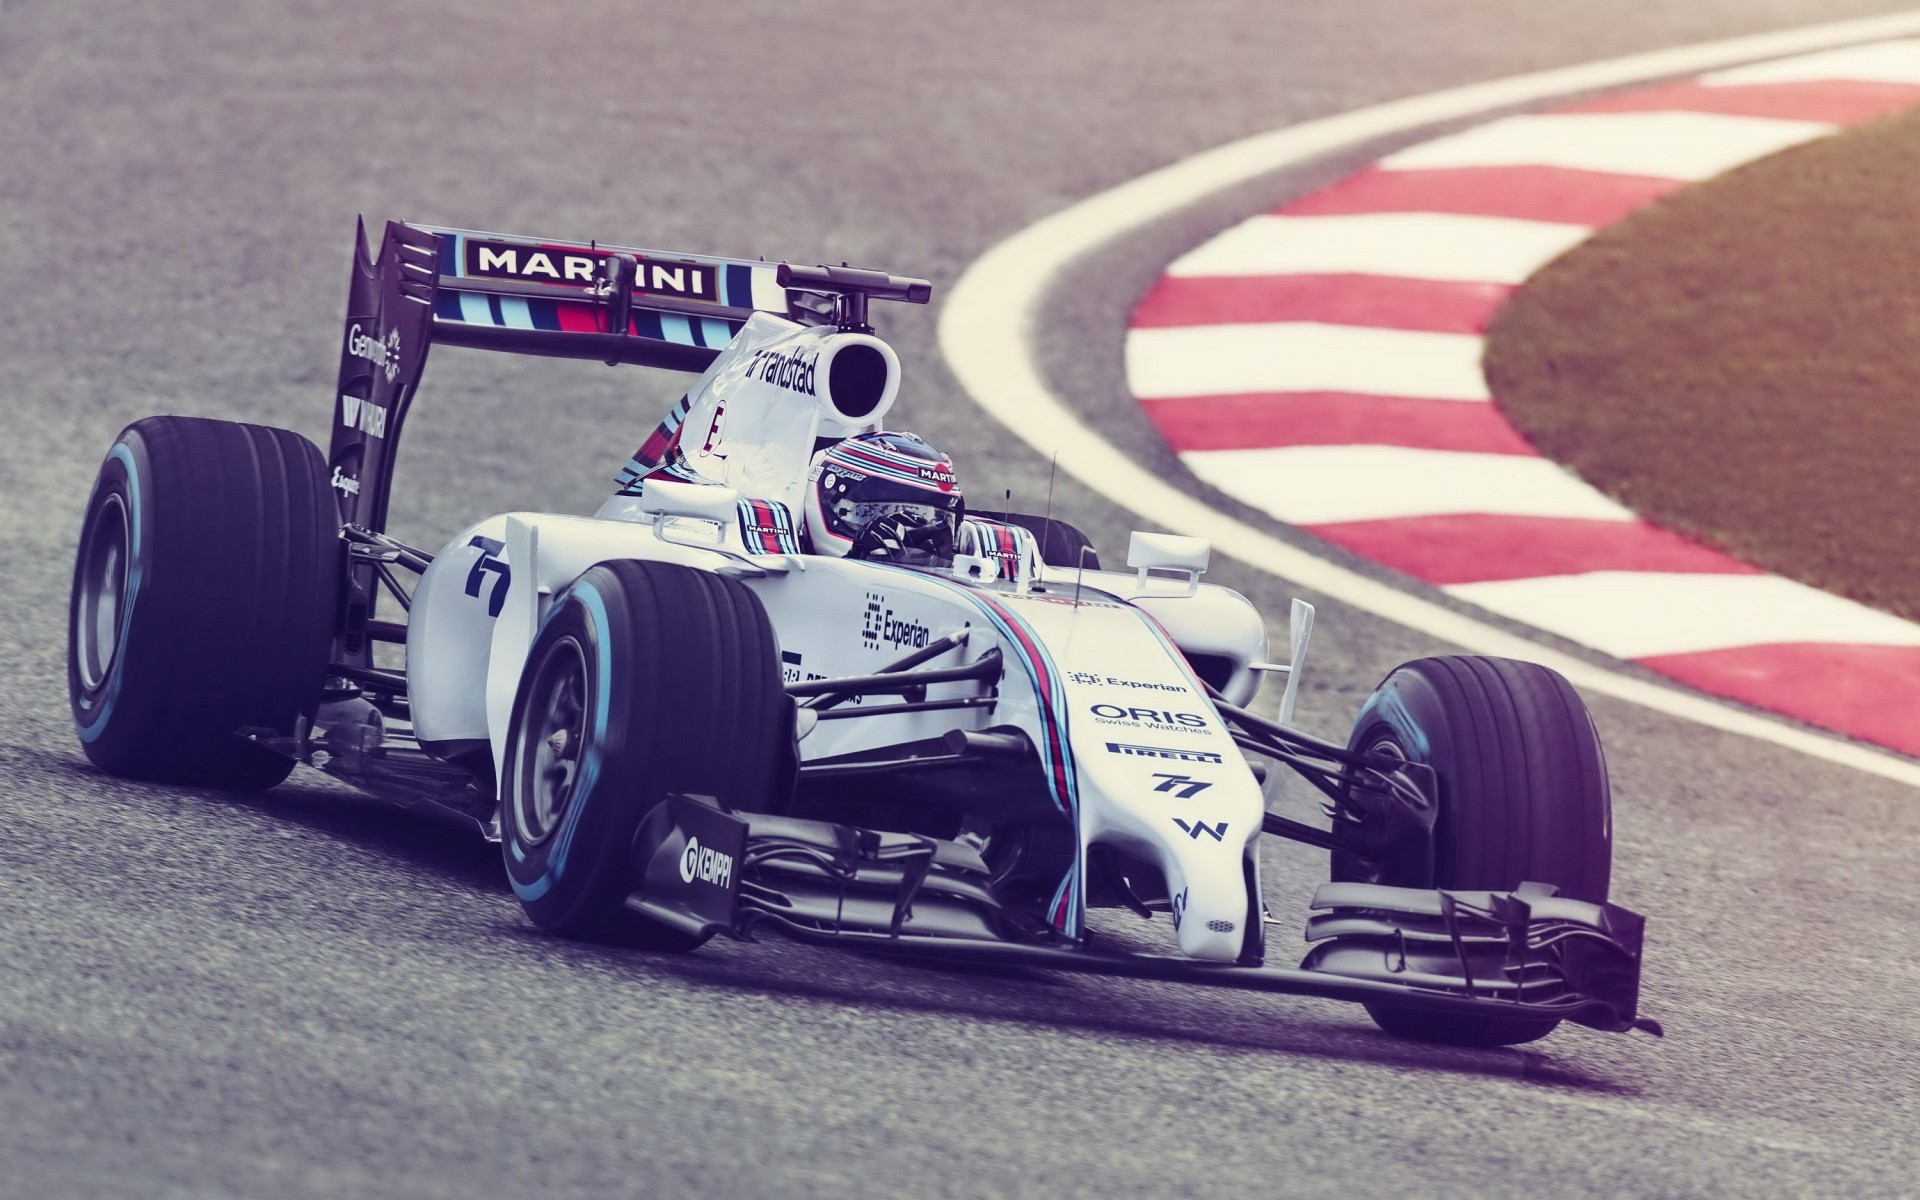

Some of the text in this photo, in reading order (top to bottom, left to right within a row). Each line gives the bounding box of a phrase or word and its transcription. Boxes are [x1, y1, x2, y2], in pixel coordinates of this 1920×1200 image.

[479, 247, 703, 294] MARINI
[759, 346, 819, 396] randstad
[748, 525, 787, 535] MARTINI
[465, 534, 511, 618] 77
[883, 609, 930, 650] Experian
[1106, 677, 1188, 693] Experian
[1090, 704, 1207, 728] ORIS
[1095, 717, 1212, 735] Swiss Watches
[1105, 742, 1223, 764] PIRELLI
[1152, 773, 1214, 799] 77
[696, 845, 733, 890] KEMPPI
